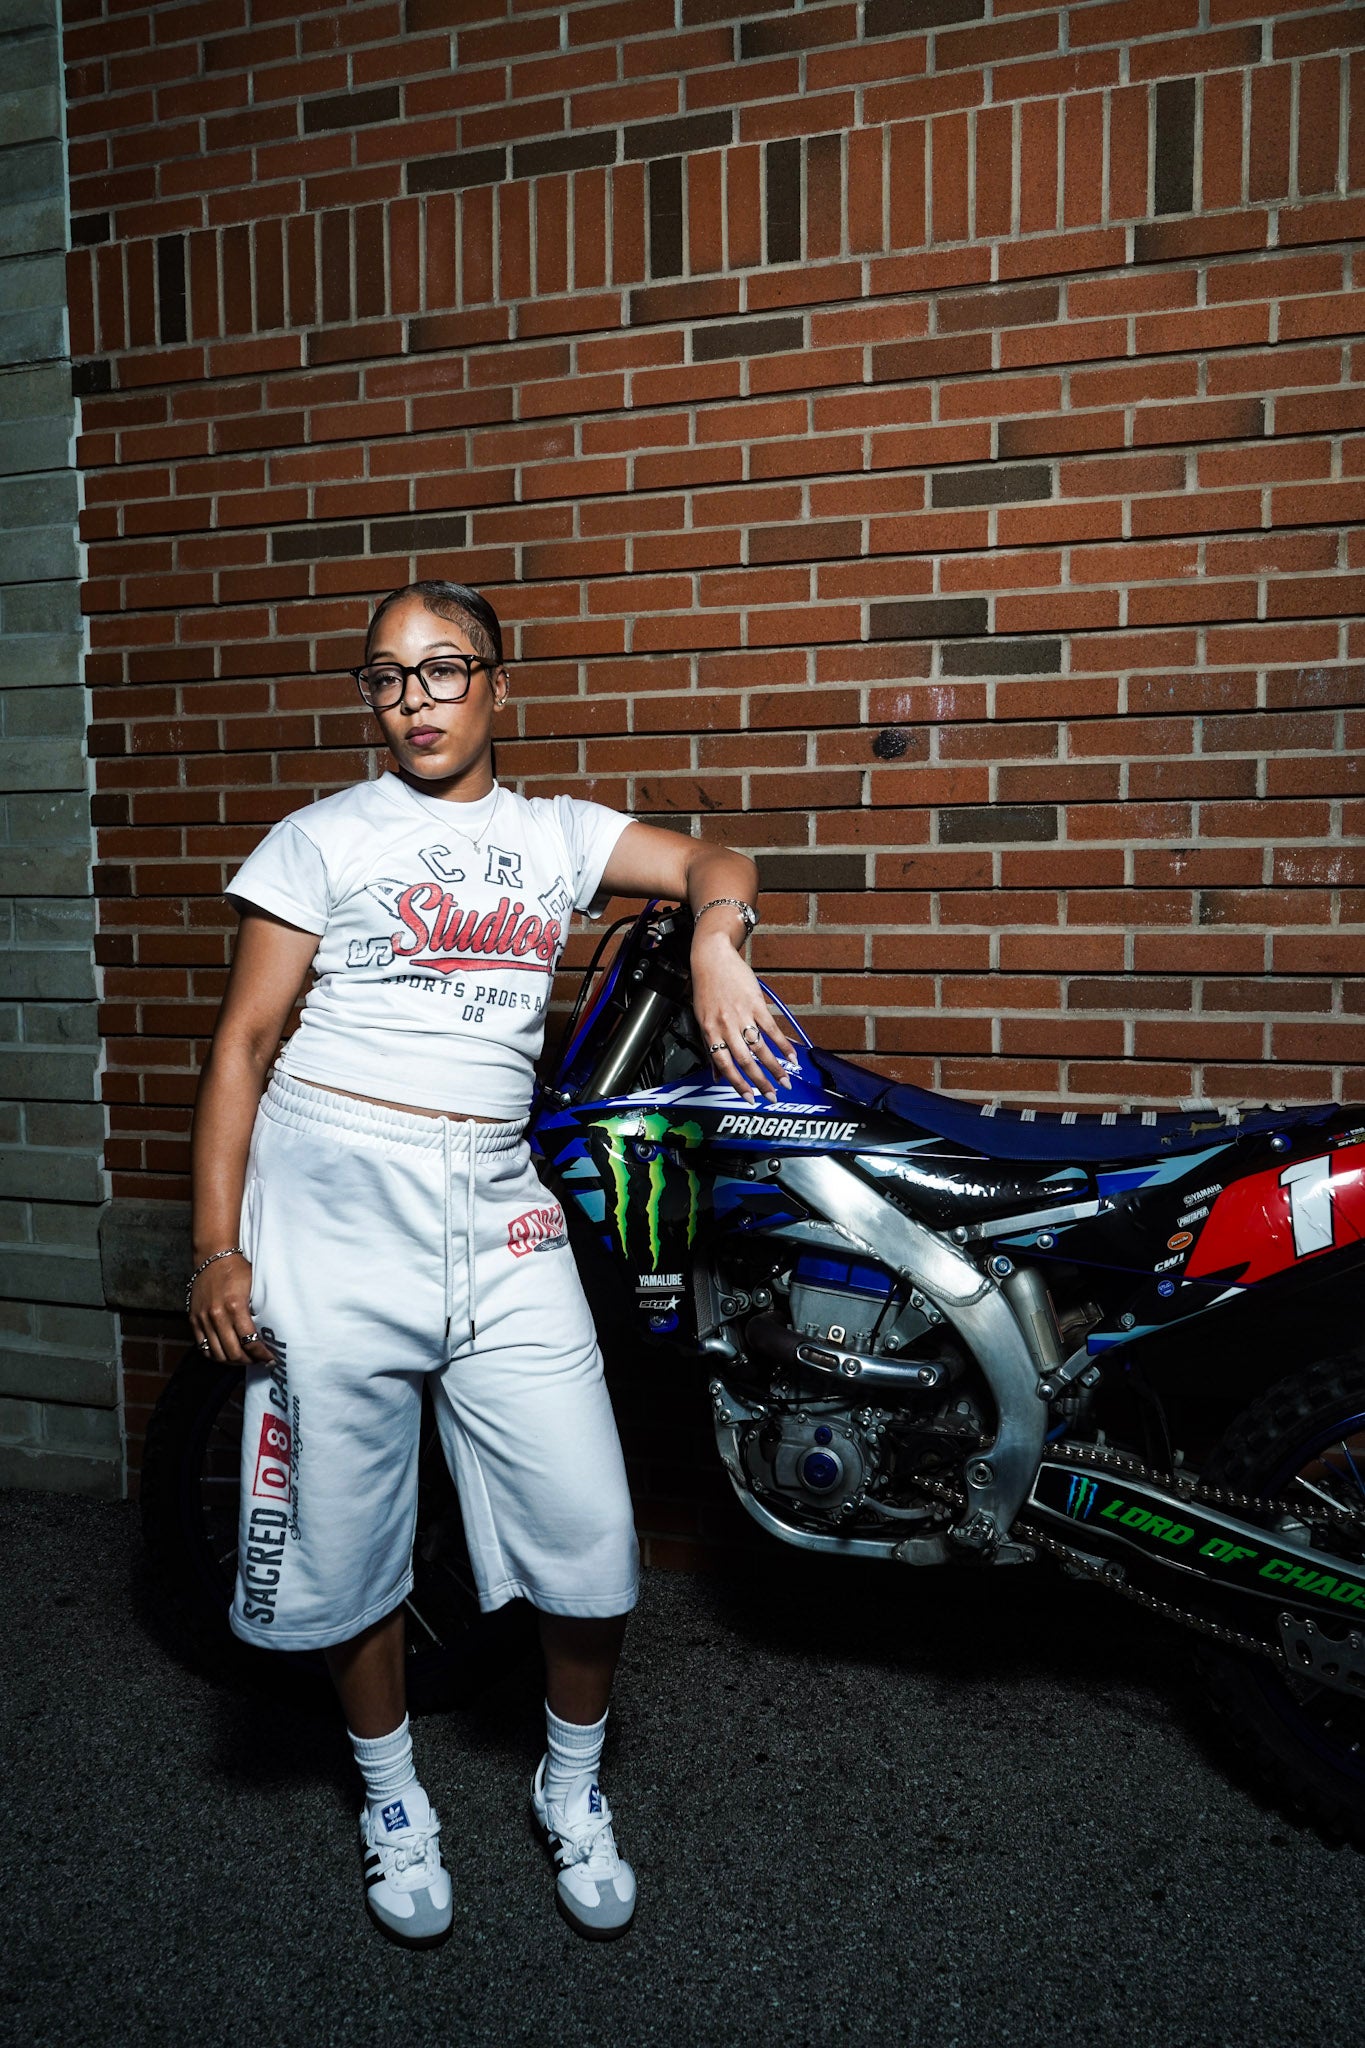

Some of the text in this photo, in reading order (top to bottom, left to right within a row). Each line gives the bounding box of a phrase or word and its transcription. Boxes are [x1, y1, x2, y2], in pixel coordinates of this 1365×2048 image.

[390, 882, 561, 961] Studios
[462, 1004, 484, 1023] 08
[762, 1102, 832, 1115] 450F
[716, 1114, 860, 1142] PROGRESSIVE
[1191, 1183, 1223, 1202] YAMAHA
[1278, 1154, 1336, 1260] 1
[638, 1273, 683, 1287] YAMALUBE
[1100, 1499, 1195, 1546] LORD
[1199, 1536, 1258, 1564] OF
[243, 1506, 288, 1625] SACRED
